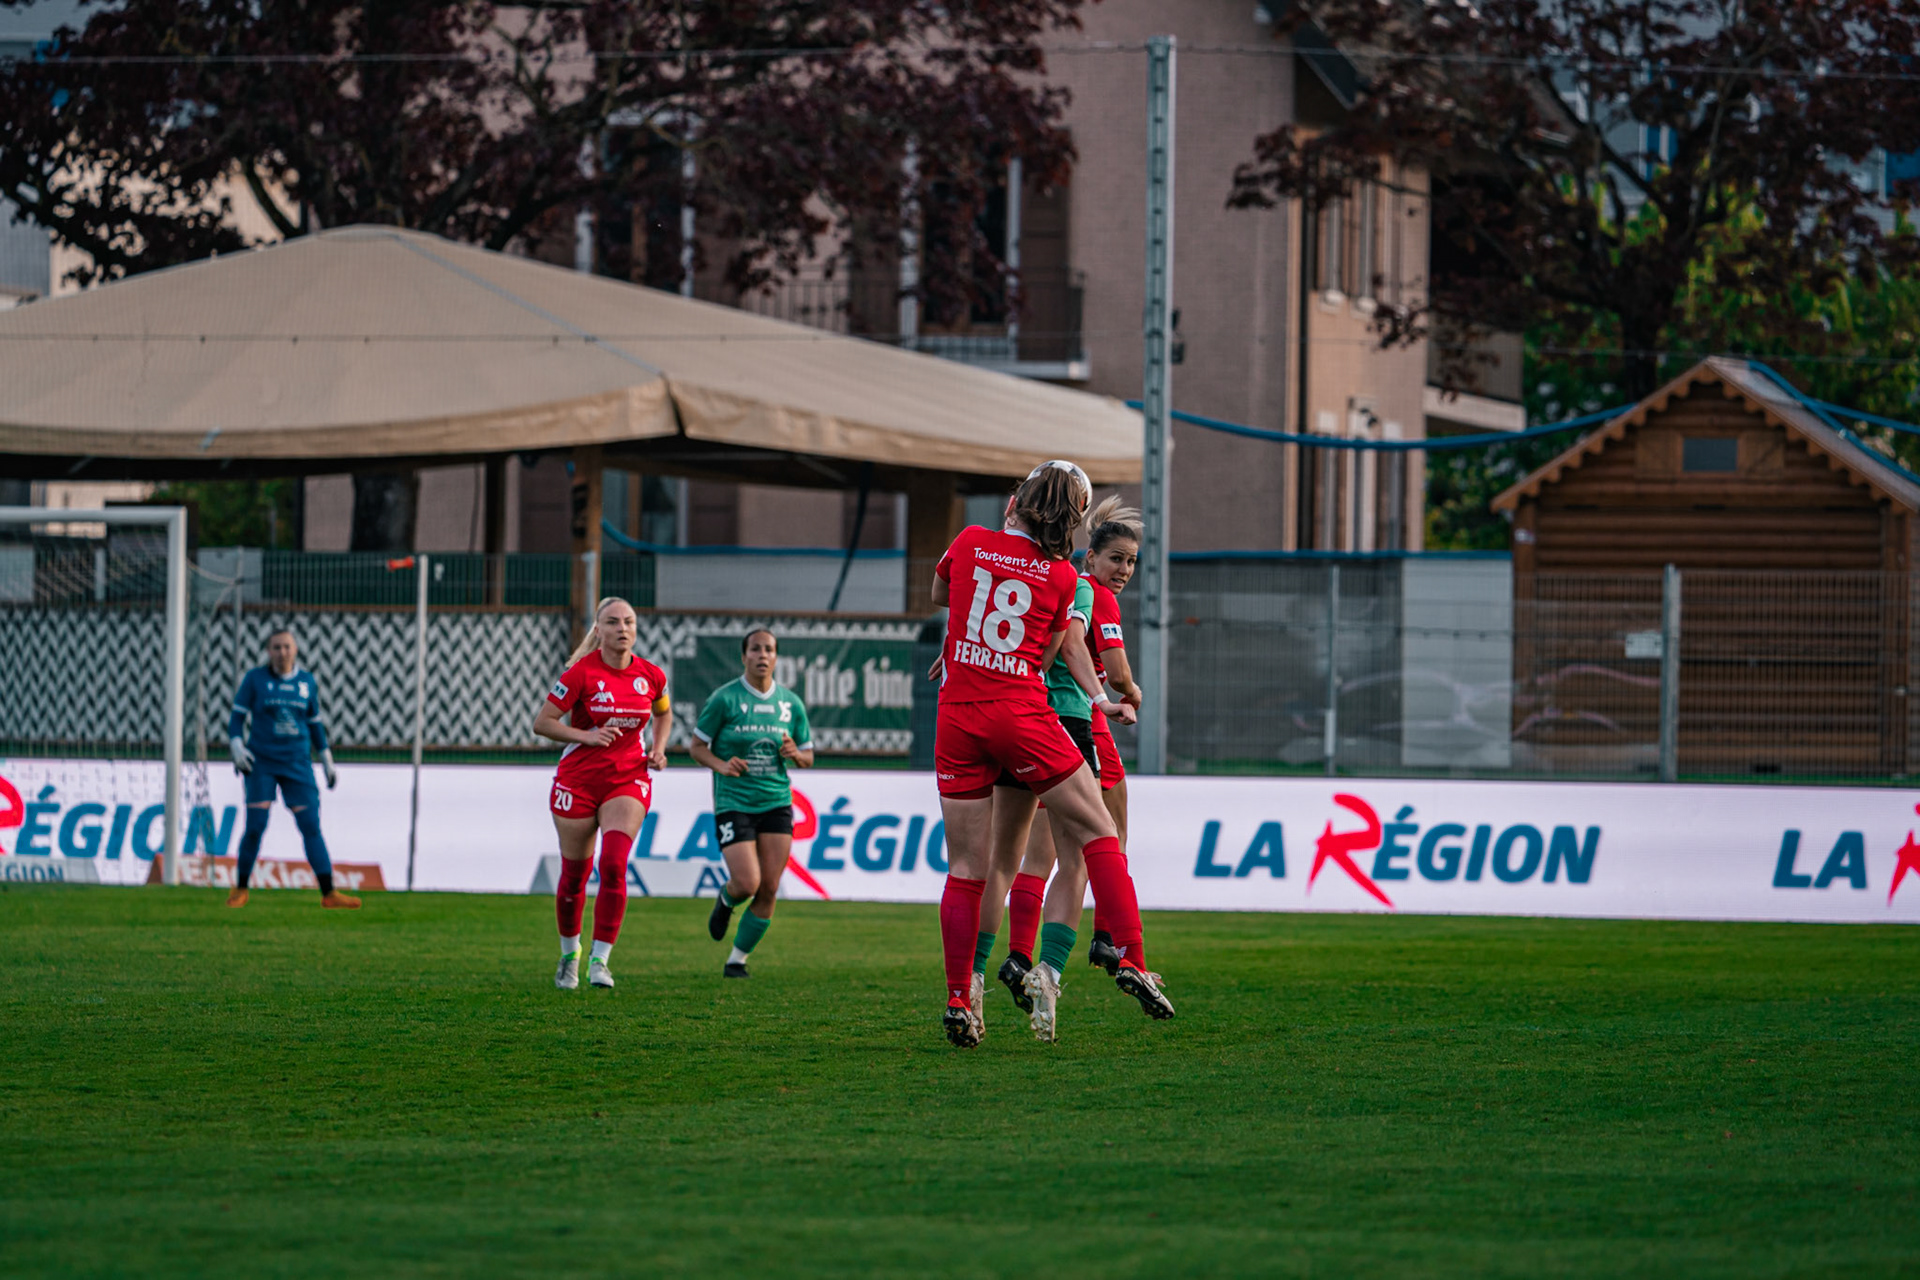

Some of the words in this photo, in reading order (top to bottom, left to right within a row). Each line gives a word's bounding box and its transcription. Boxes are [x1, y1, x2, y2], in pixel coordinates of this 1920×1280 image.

[974, 547, 1028, 567] Toutvent
[1029, 558, 1051, 571] AG
[965, 566, 1032, 653] 18
[954, 640, 1028, 676] FERRARA
[0, 775, 237, 862] ÉGION
[554, 789, 573, 811] 20
[0, 862, 65, 882] GION
[1194, 820, 1286, 879] LA
[1307, 793, 1601, 909] RÉGION
[1773, 829, 1867, 889] LA
